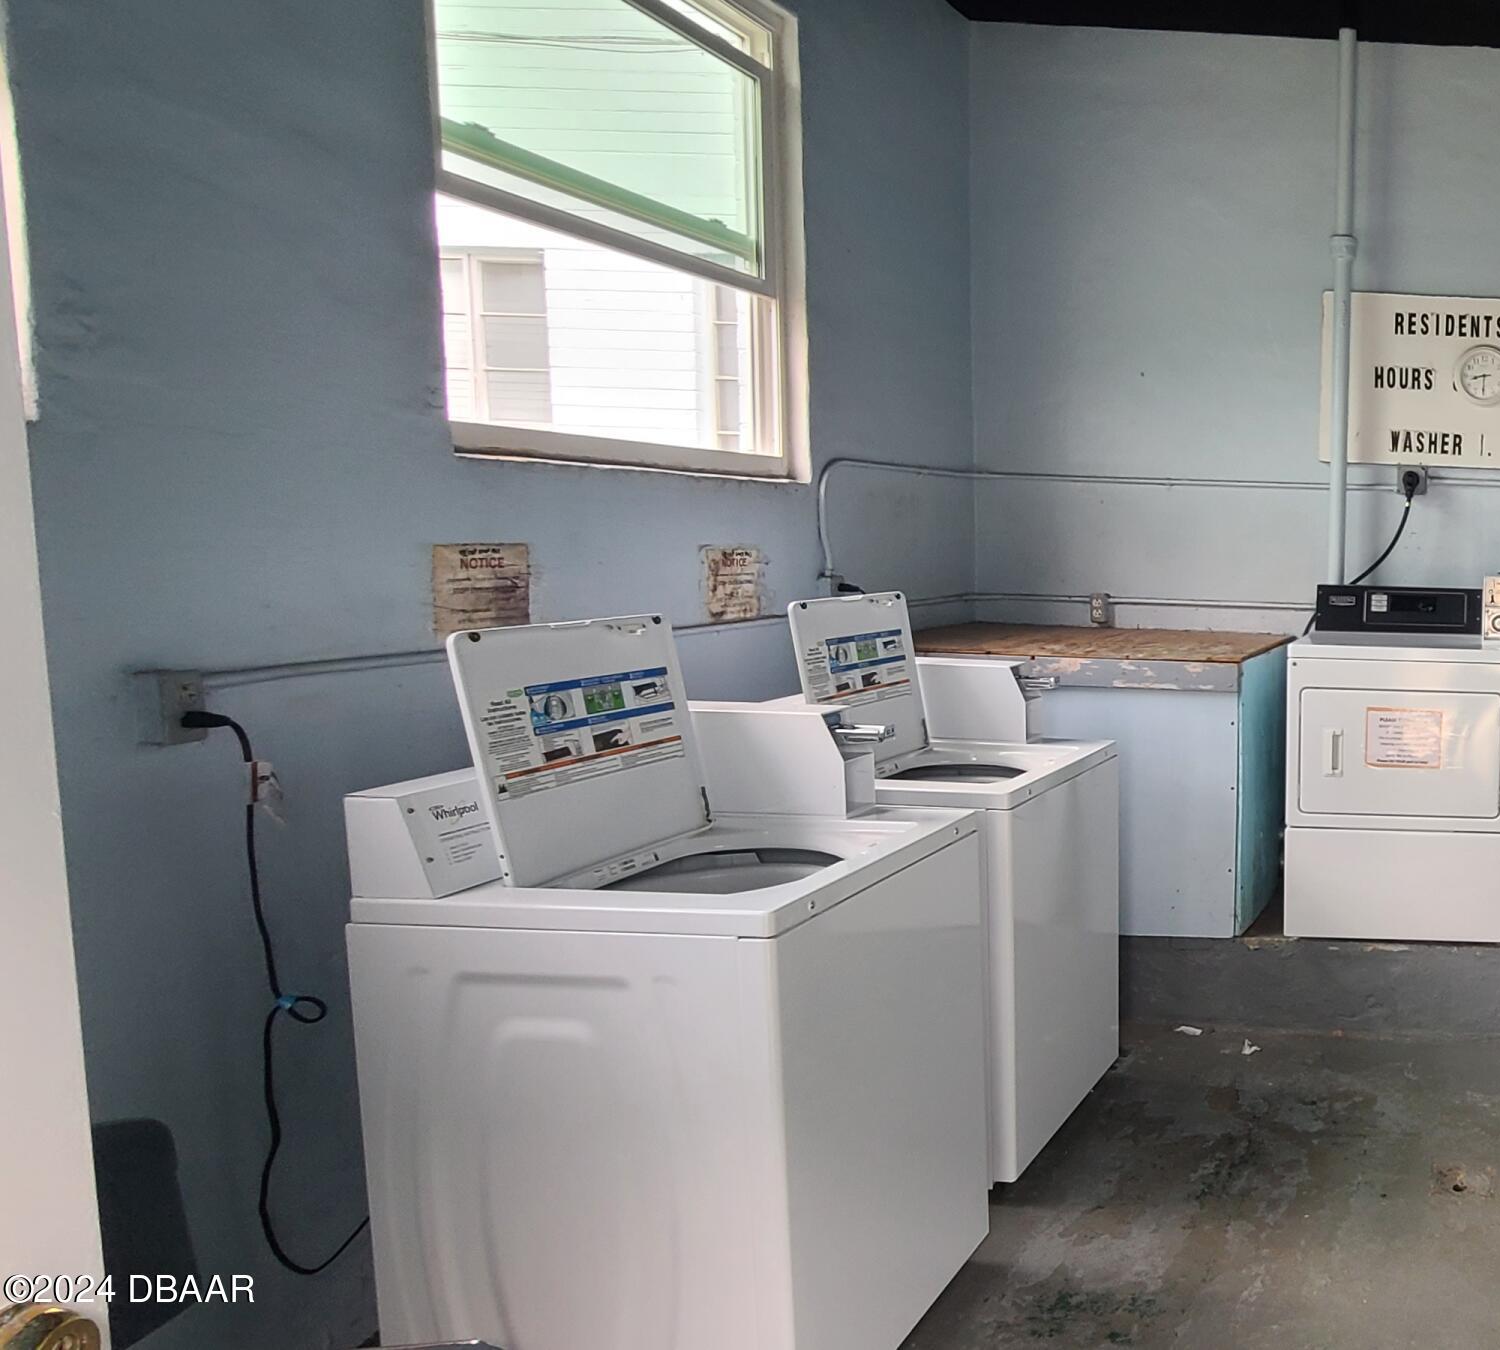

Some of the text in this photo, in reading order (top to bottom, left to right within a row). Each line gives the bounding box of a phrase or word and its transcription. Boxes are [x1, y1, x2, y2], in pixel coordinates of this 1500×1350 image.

[1373, 366, 1434, 391] HOURS
[1390, 430, 1463, 456] WASHER
[460, 557, 505, 570] NOTICE
[431, 801, 479, 821] Whirlpool
